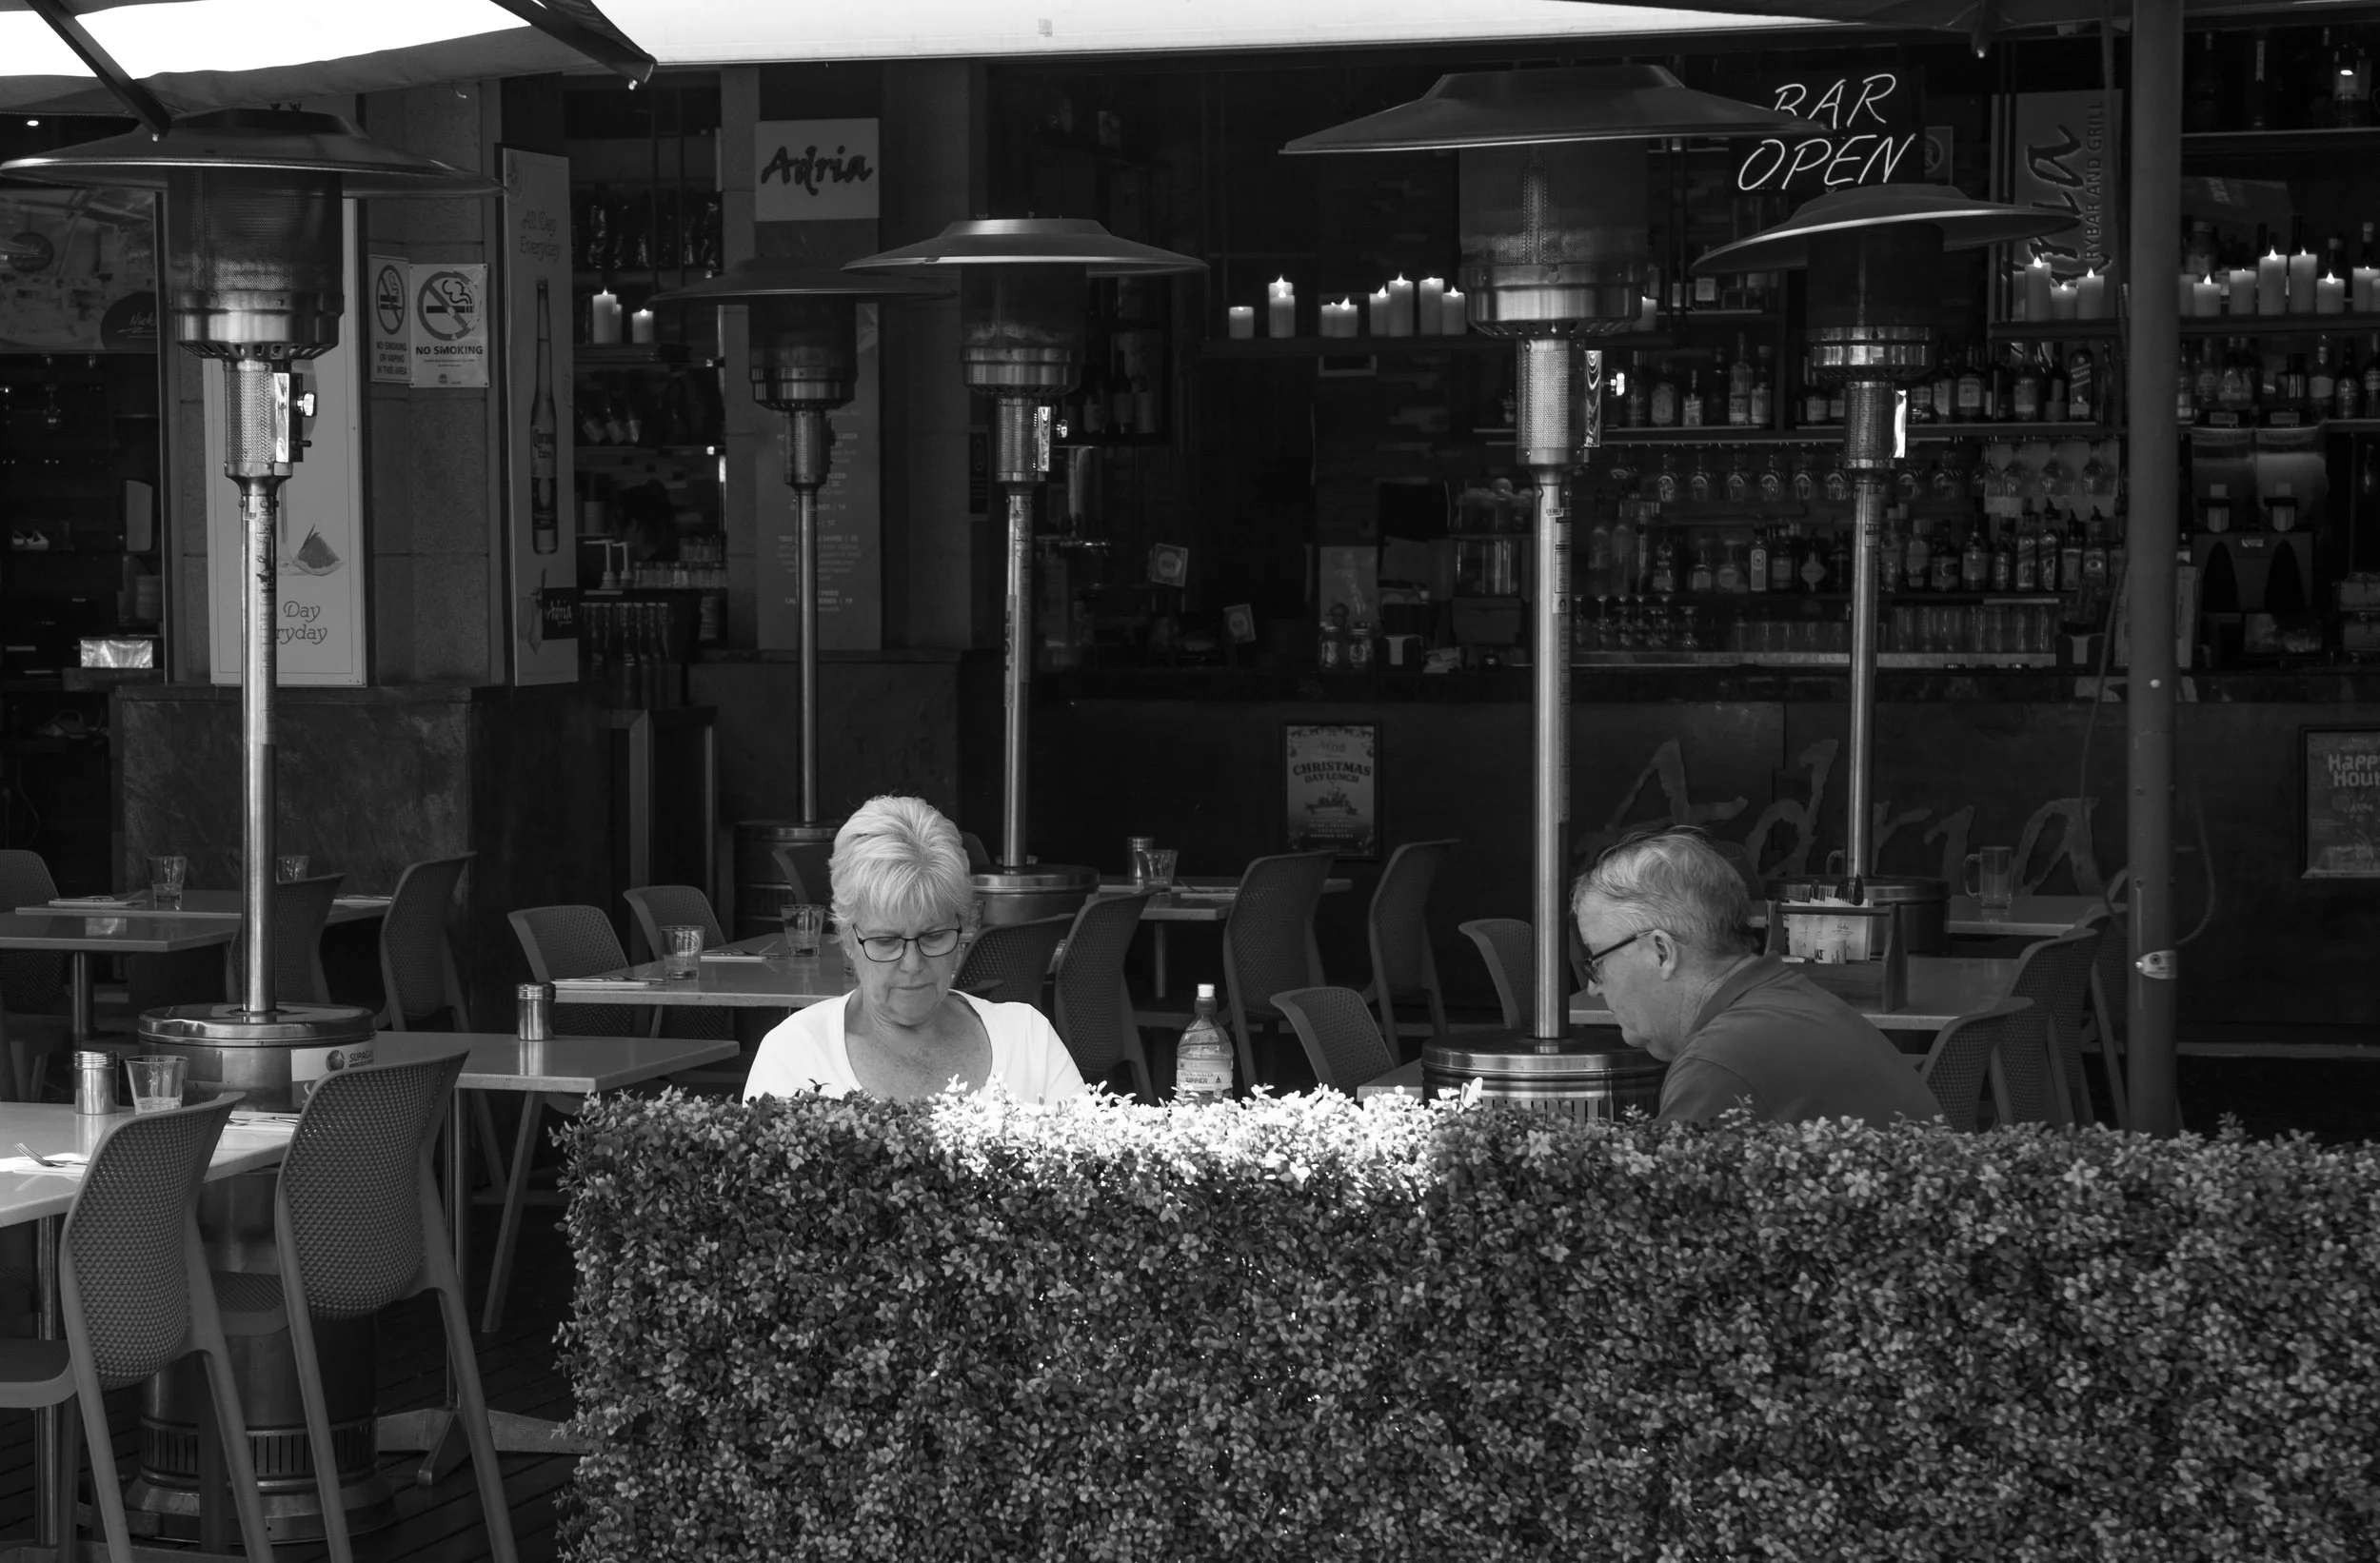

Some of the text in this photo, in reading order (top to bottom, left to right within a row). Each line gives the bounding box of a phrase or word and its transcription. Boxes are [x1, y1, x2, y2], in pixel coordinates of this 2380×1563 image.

[2087, 101, 2105, 152] GRILL
[762, 145, 873, 196] Adria
[1738, 134, 1916, 190] OPEN
[2086, 157, 2102, 197] AND
[415, 346, 484, 355] NO SMOKING
[283, 601, 321, 623] Day
[276, 623, 328, 644] ryday
[1292, 762, 1372, 777] CHRISTMAS
[1304, 772, 1360, 783] DAY LUNCH
